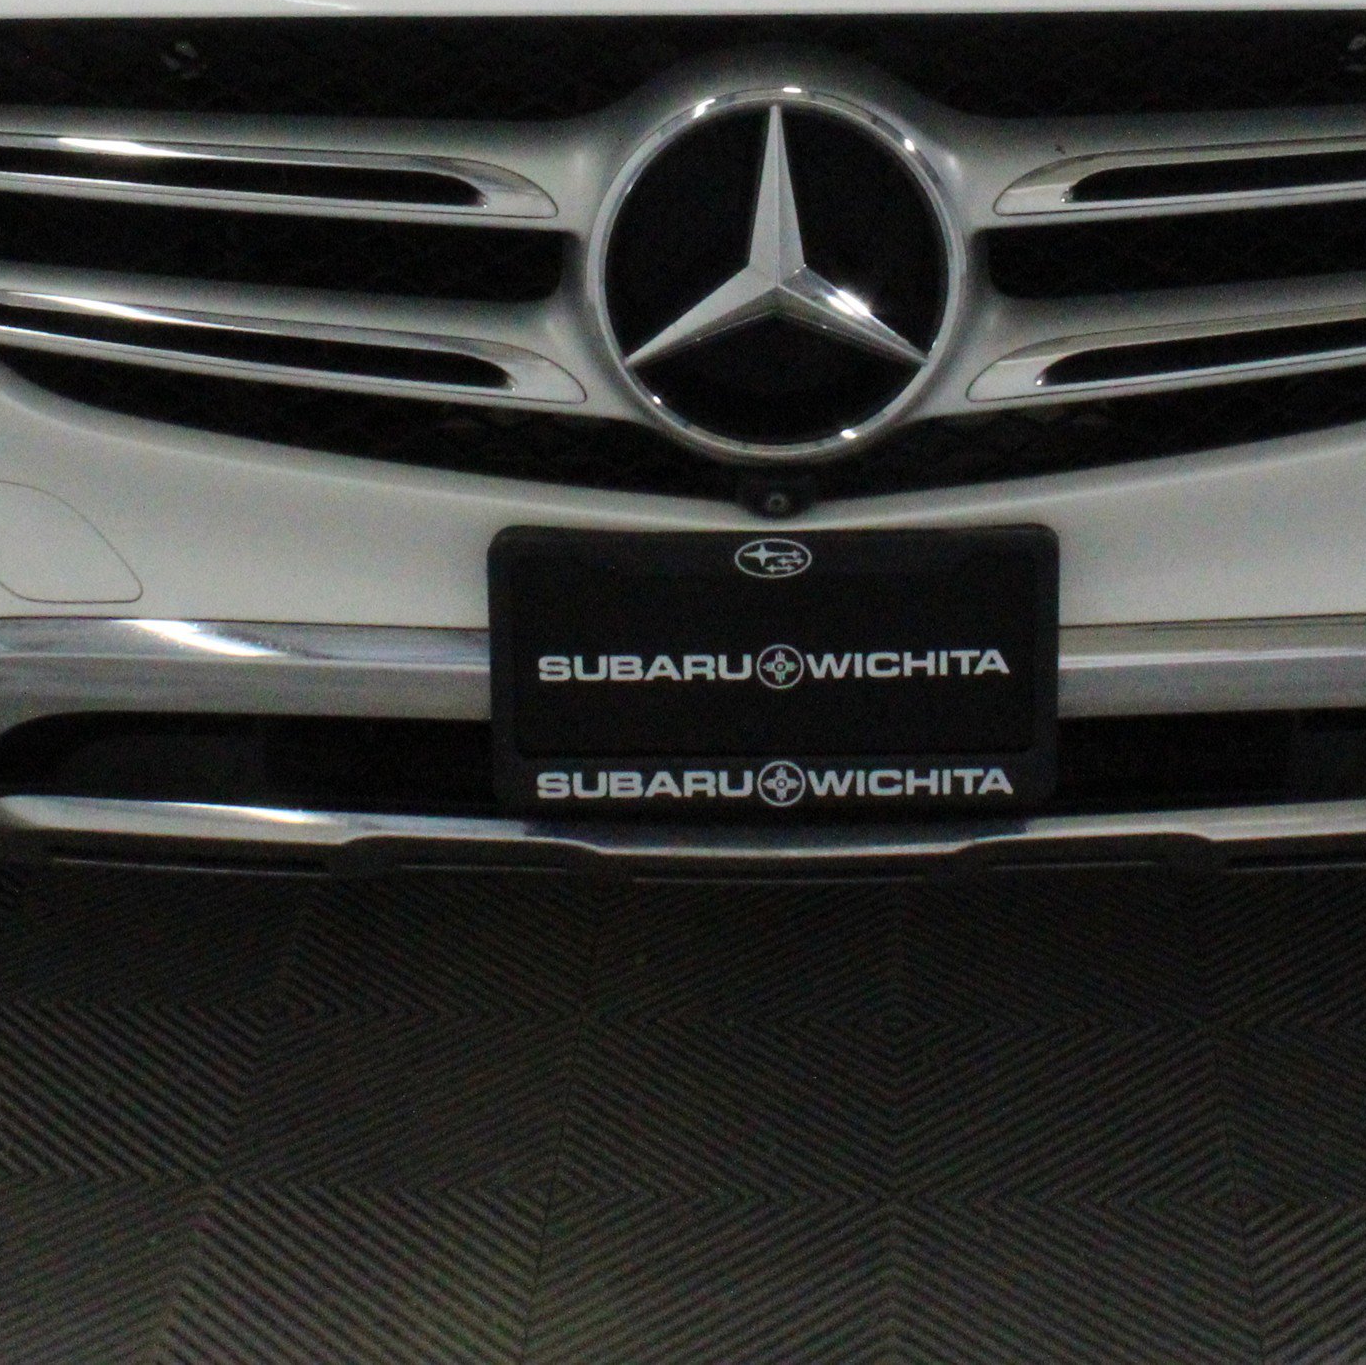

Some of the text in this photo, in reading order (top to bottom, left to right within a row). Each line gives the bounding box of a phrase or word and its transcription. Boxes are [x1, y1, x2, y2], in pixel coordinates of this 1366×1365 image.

[538, 649, 1010, 681] SUBARU WICHITA
[536, 768, 1014, 799] SUBARU WICHITA
